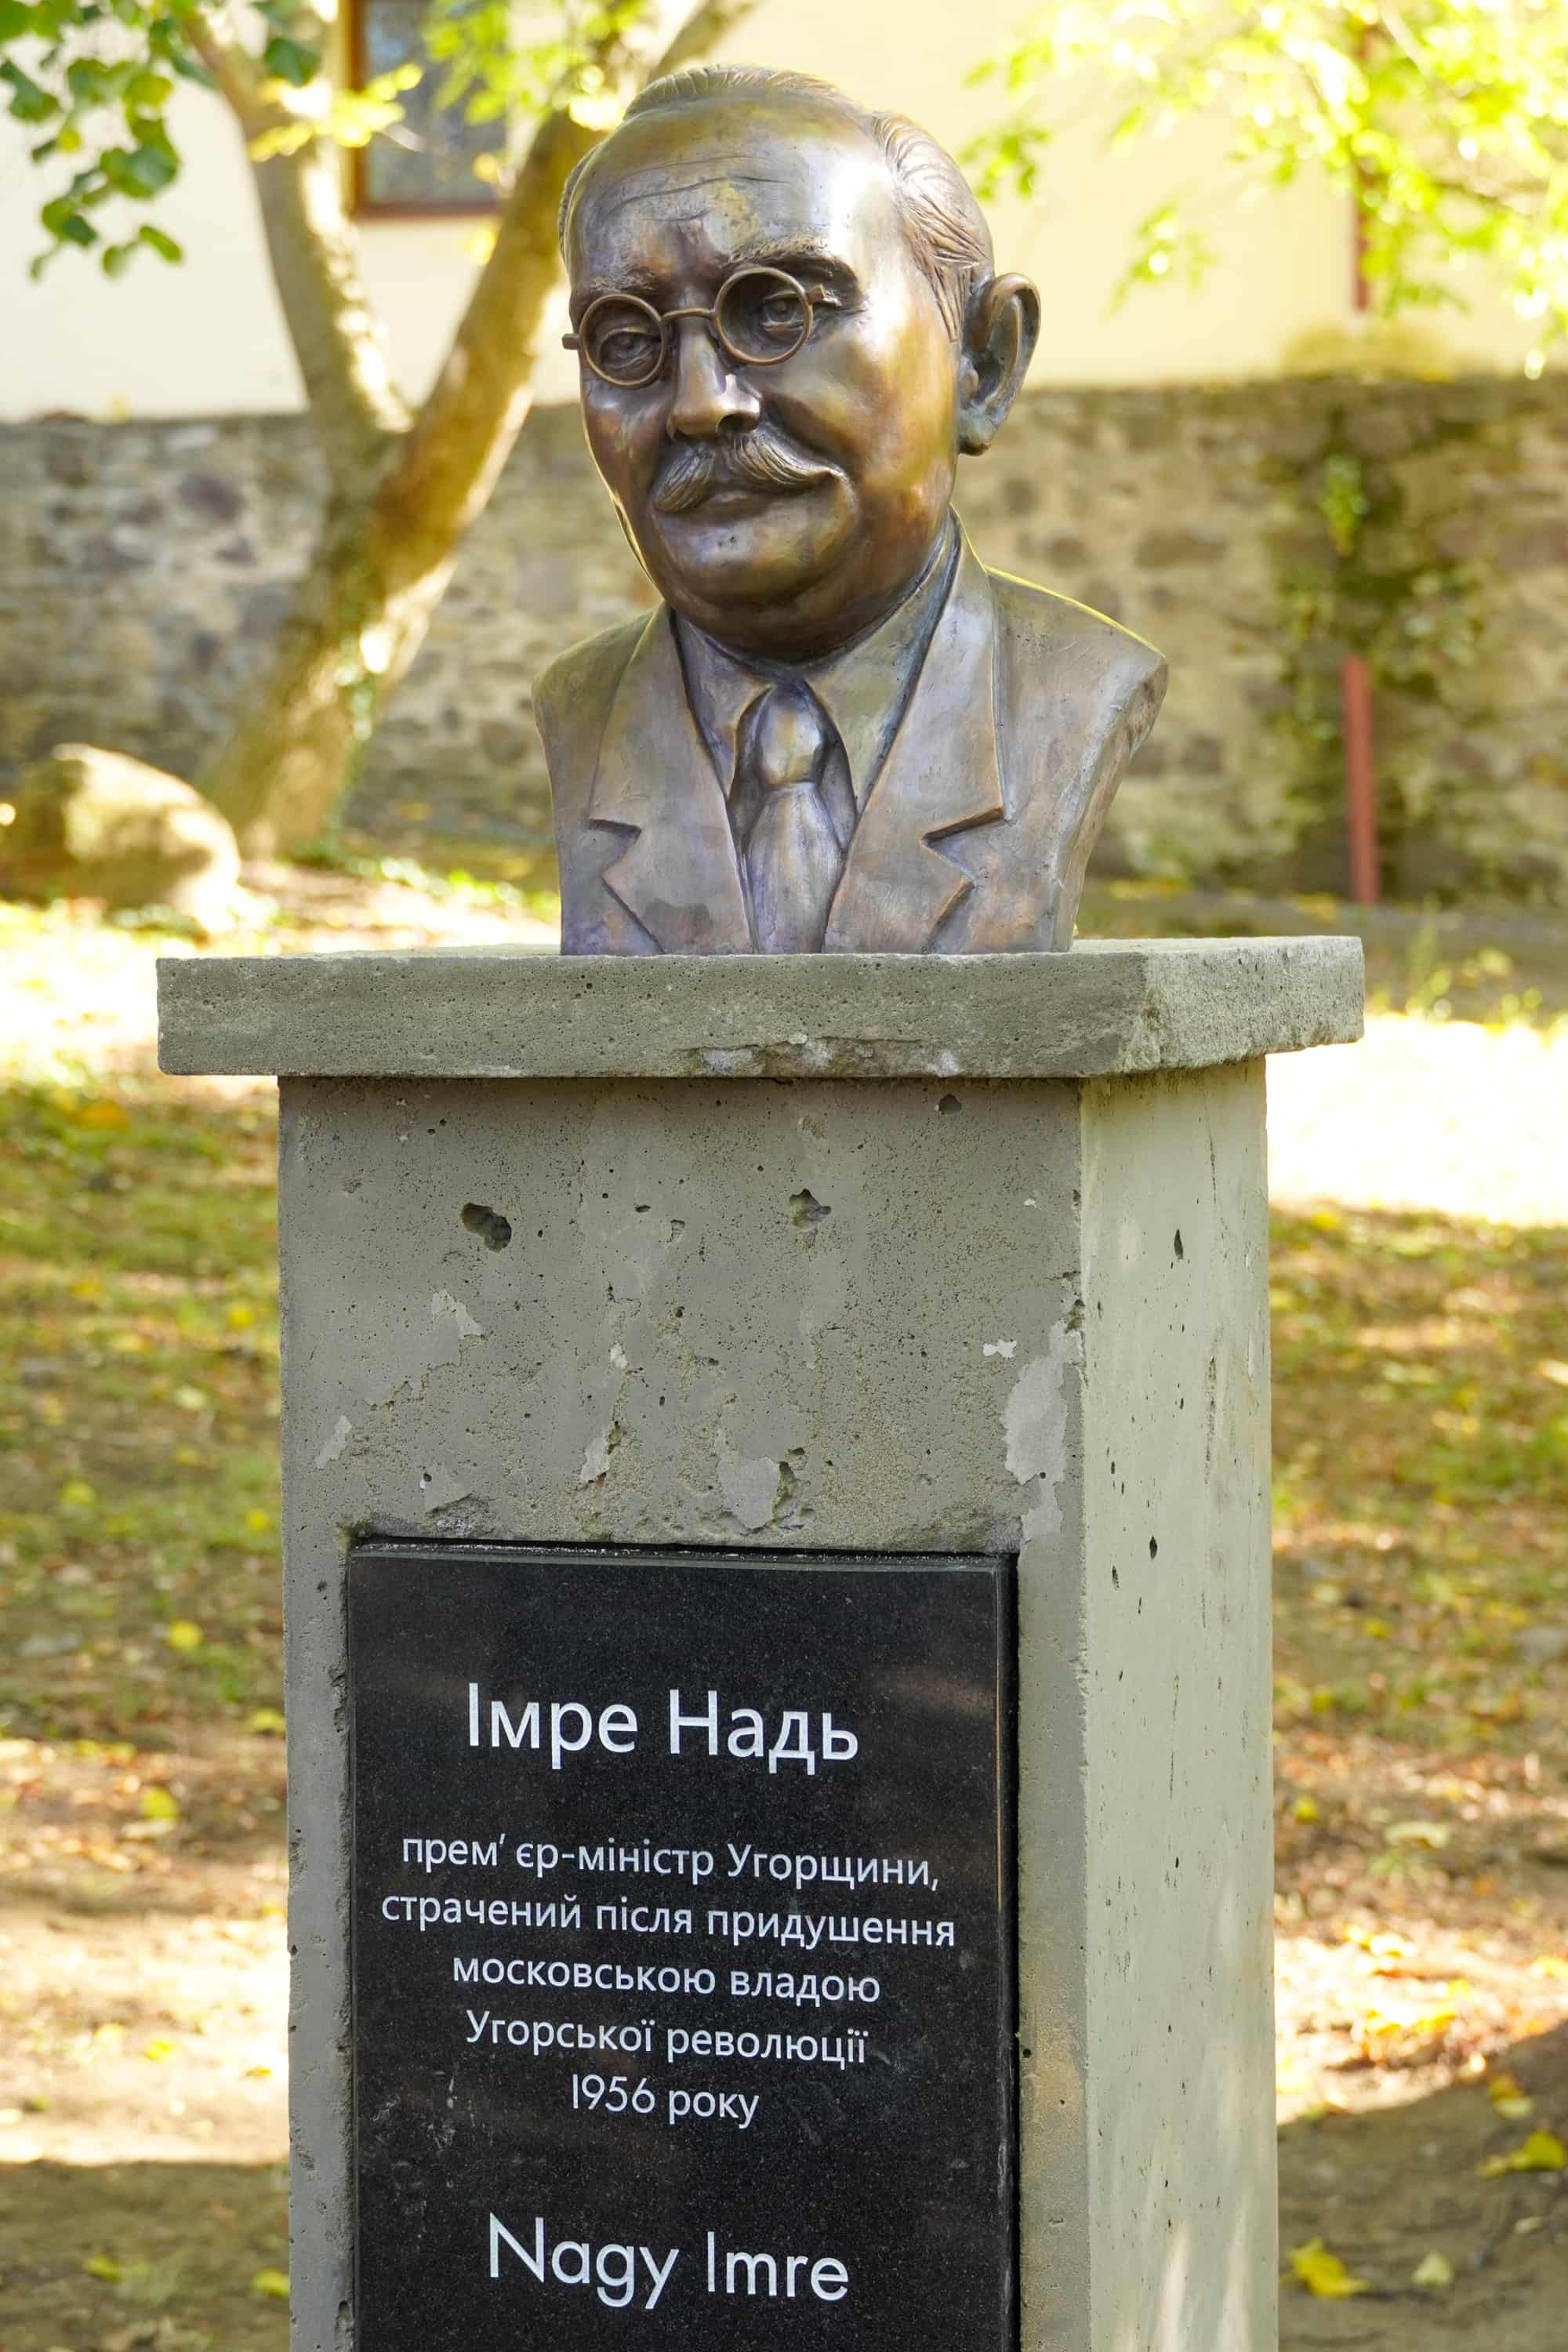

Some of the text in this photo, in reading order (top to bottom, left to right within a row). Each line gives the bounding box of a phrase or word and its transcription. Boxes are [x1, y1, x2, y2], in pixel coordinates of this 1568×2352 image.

[467, 1682, 859, 1776] Імре Надь
[726, 1843, 939, 1892] Угорщини,
[381, 1894, 955, 1951] страчений після придушення
[452, 1957, 881, 2008] московською владою
[465, 2009, 869, 2071] Угорської революції
[572, 2074, 760, 2129] 1956 року
[488, 2212, 850, 2310] Nagy Imre
